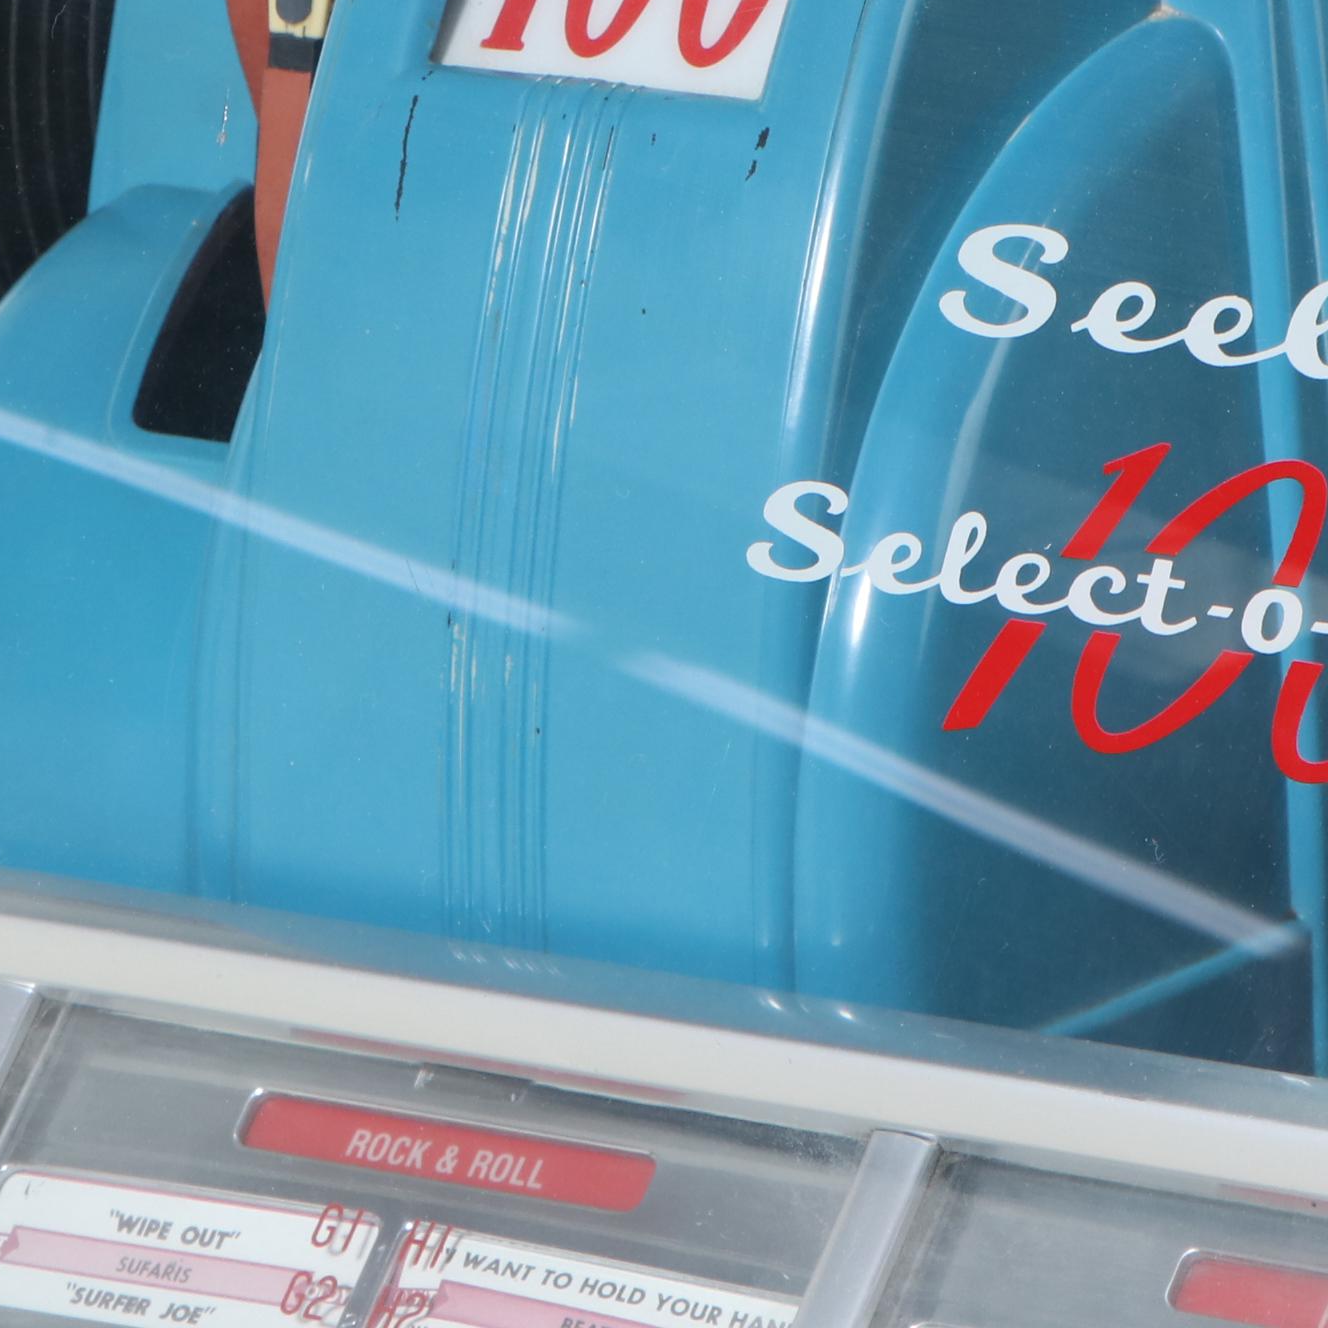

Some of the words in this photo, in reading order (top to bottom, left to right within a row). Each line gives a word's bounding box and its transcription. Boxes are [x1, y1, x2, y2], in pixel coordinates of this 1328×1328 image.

[346, 1129, 432, 1169] ROCK
[435, 1144, 460, 1174] &
[467, 1150, 544, 1189] ROLL
[311, 1202, 364, 1252] G1
[116, 1256, 193, 1284] SUFARIS
[463, 1252, 535, 1282] WANT
[540, 1270, 572, 1290] TO
[579, 1278, 646, 1305] HOLD
[655, 1295, 722, 1325] YOUR
